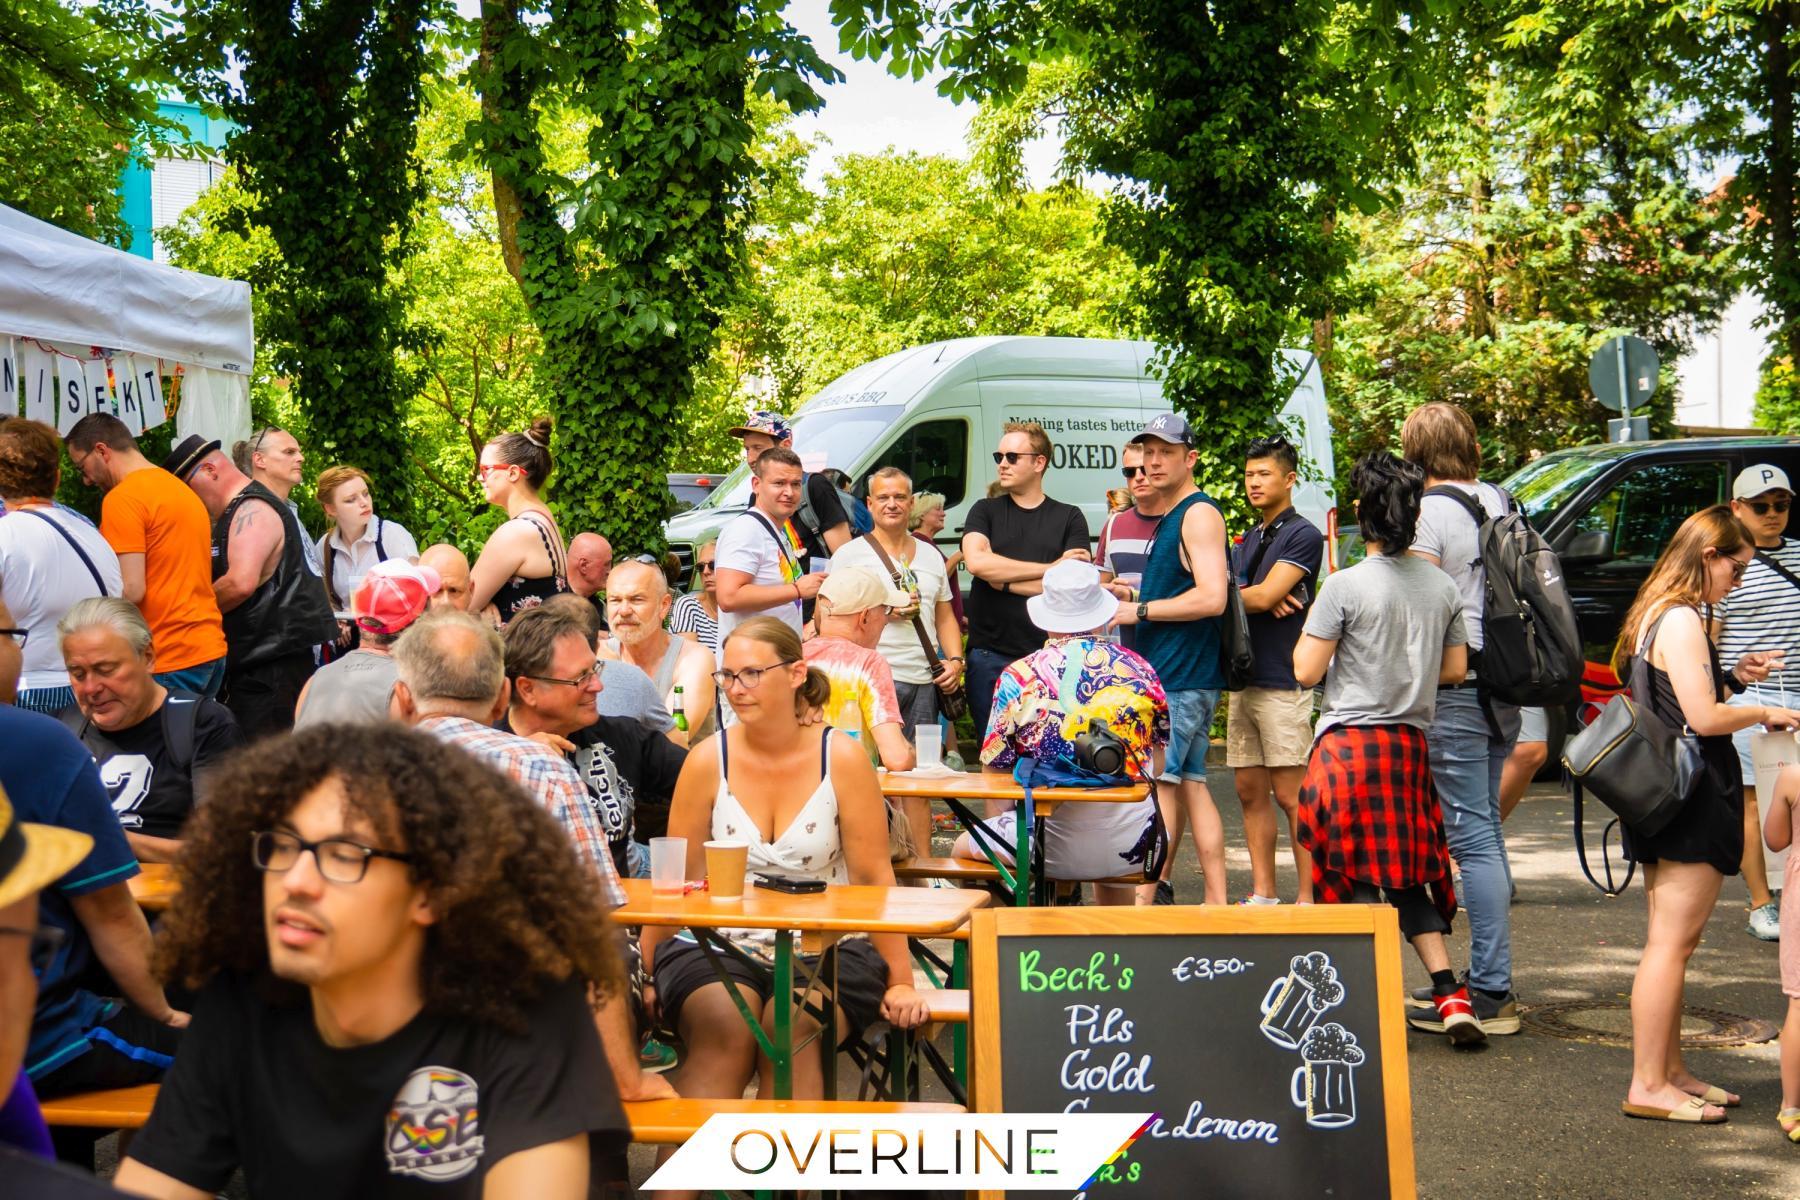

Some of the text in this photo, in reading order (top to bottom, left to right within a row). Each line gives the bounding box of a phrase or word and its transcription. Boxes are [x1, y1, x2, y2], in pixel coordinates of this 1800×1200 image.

[1067, 417, 1108, 431] tastes
[1048, 443, 1117, 469] OKED
[1761, 469, 1774, 485] P
[1145, 850, 1153, 872] Canon
[1019, 950, 1135, 992] Beck's
[1064, 1003, 1134, 1045] Pils
[1060, 1048, 1156, 1093] Gold
[1172, 1100, 1279, 1143] Lemon
